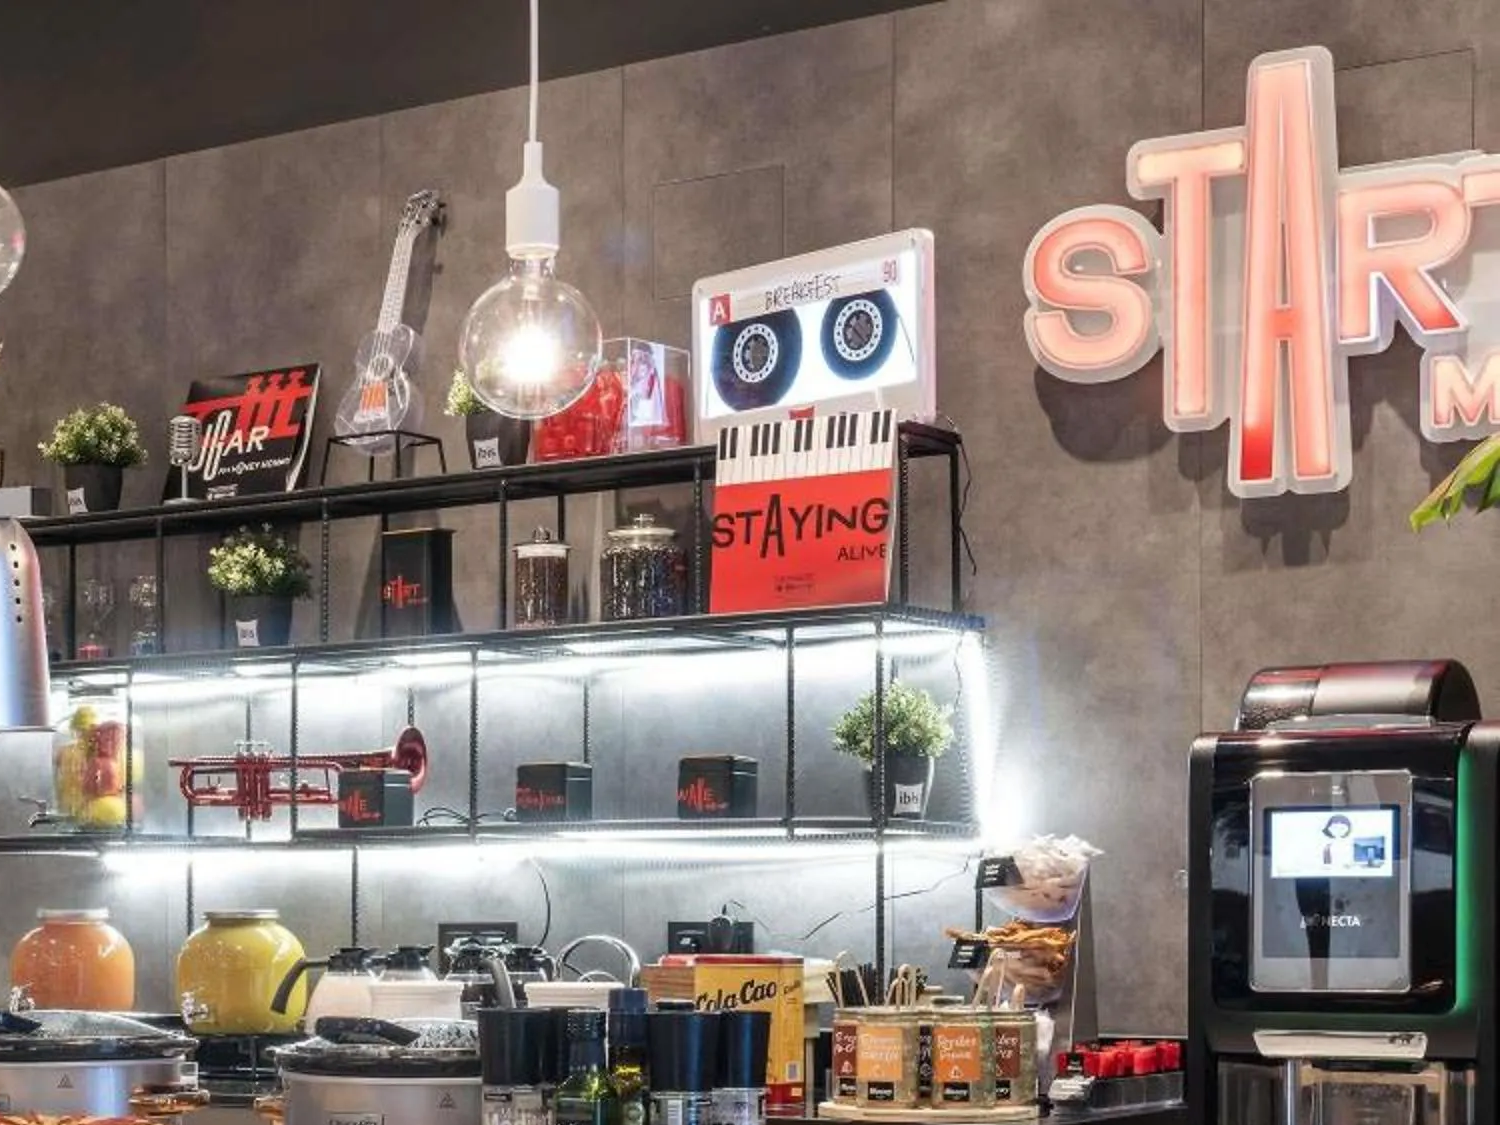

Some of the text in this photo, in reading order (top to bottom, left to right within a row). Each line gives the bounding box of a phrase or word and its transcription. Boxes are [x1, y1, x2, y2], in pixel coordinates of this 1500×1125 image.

[1028, 58, 1500, 484] STAR
[712, 306, 726, 322] A
[188, 410, 270, 481] UGAR
[712, 494, 890, 559] STAYING
[837, 543, 887, 561] ALIVE
[696, 988, 738, 1011] Cola
[740, 979, 777, 1004] Cao
